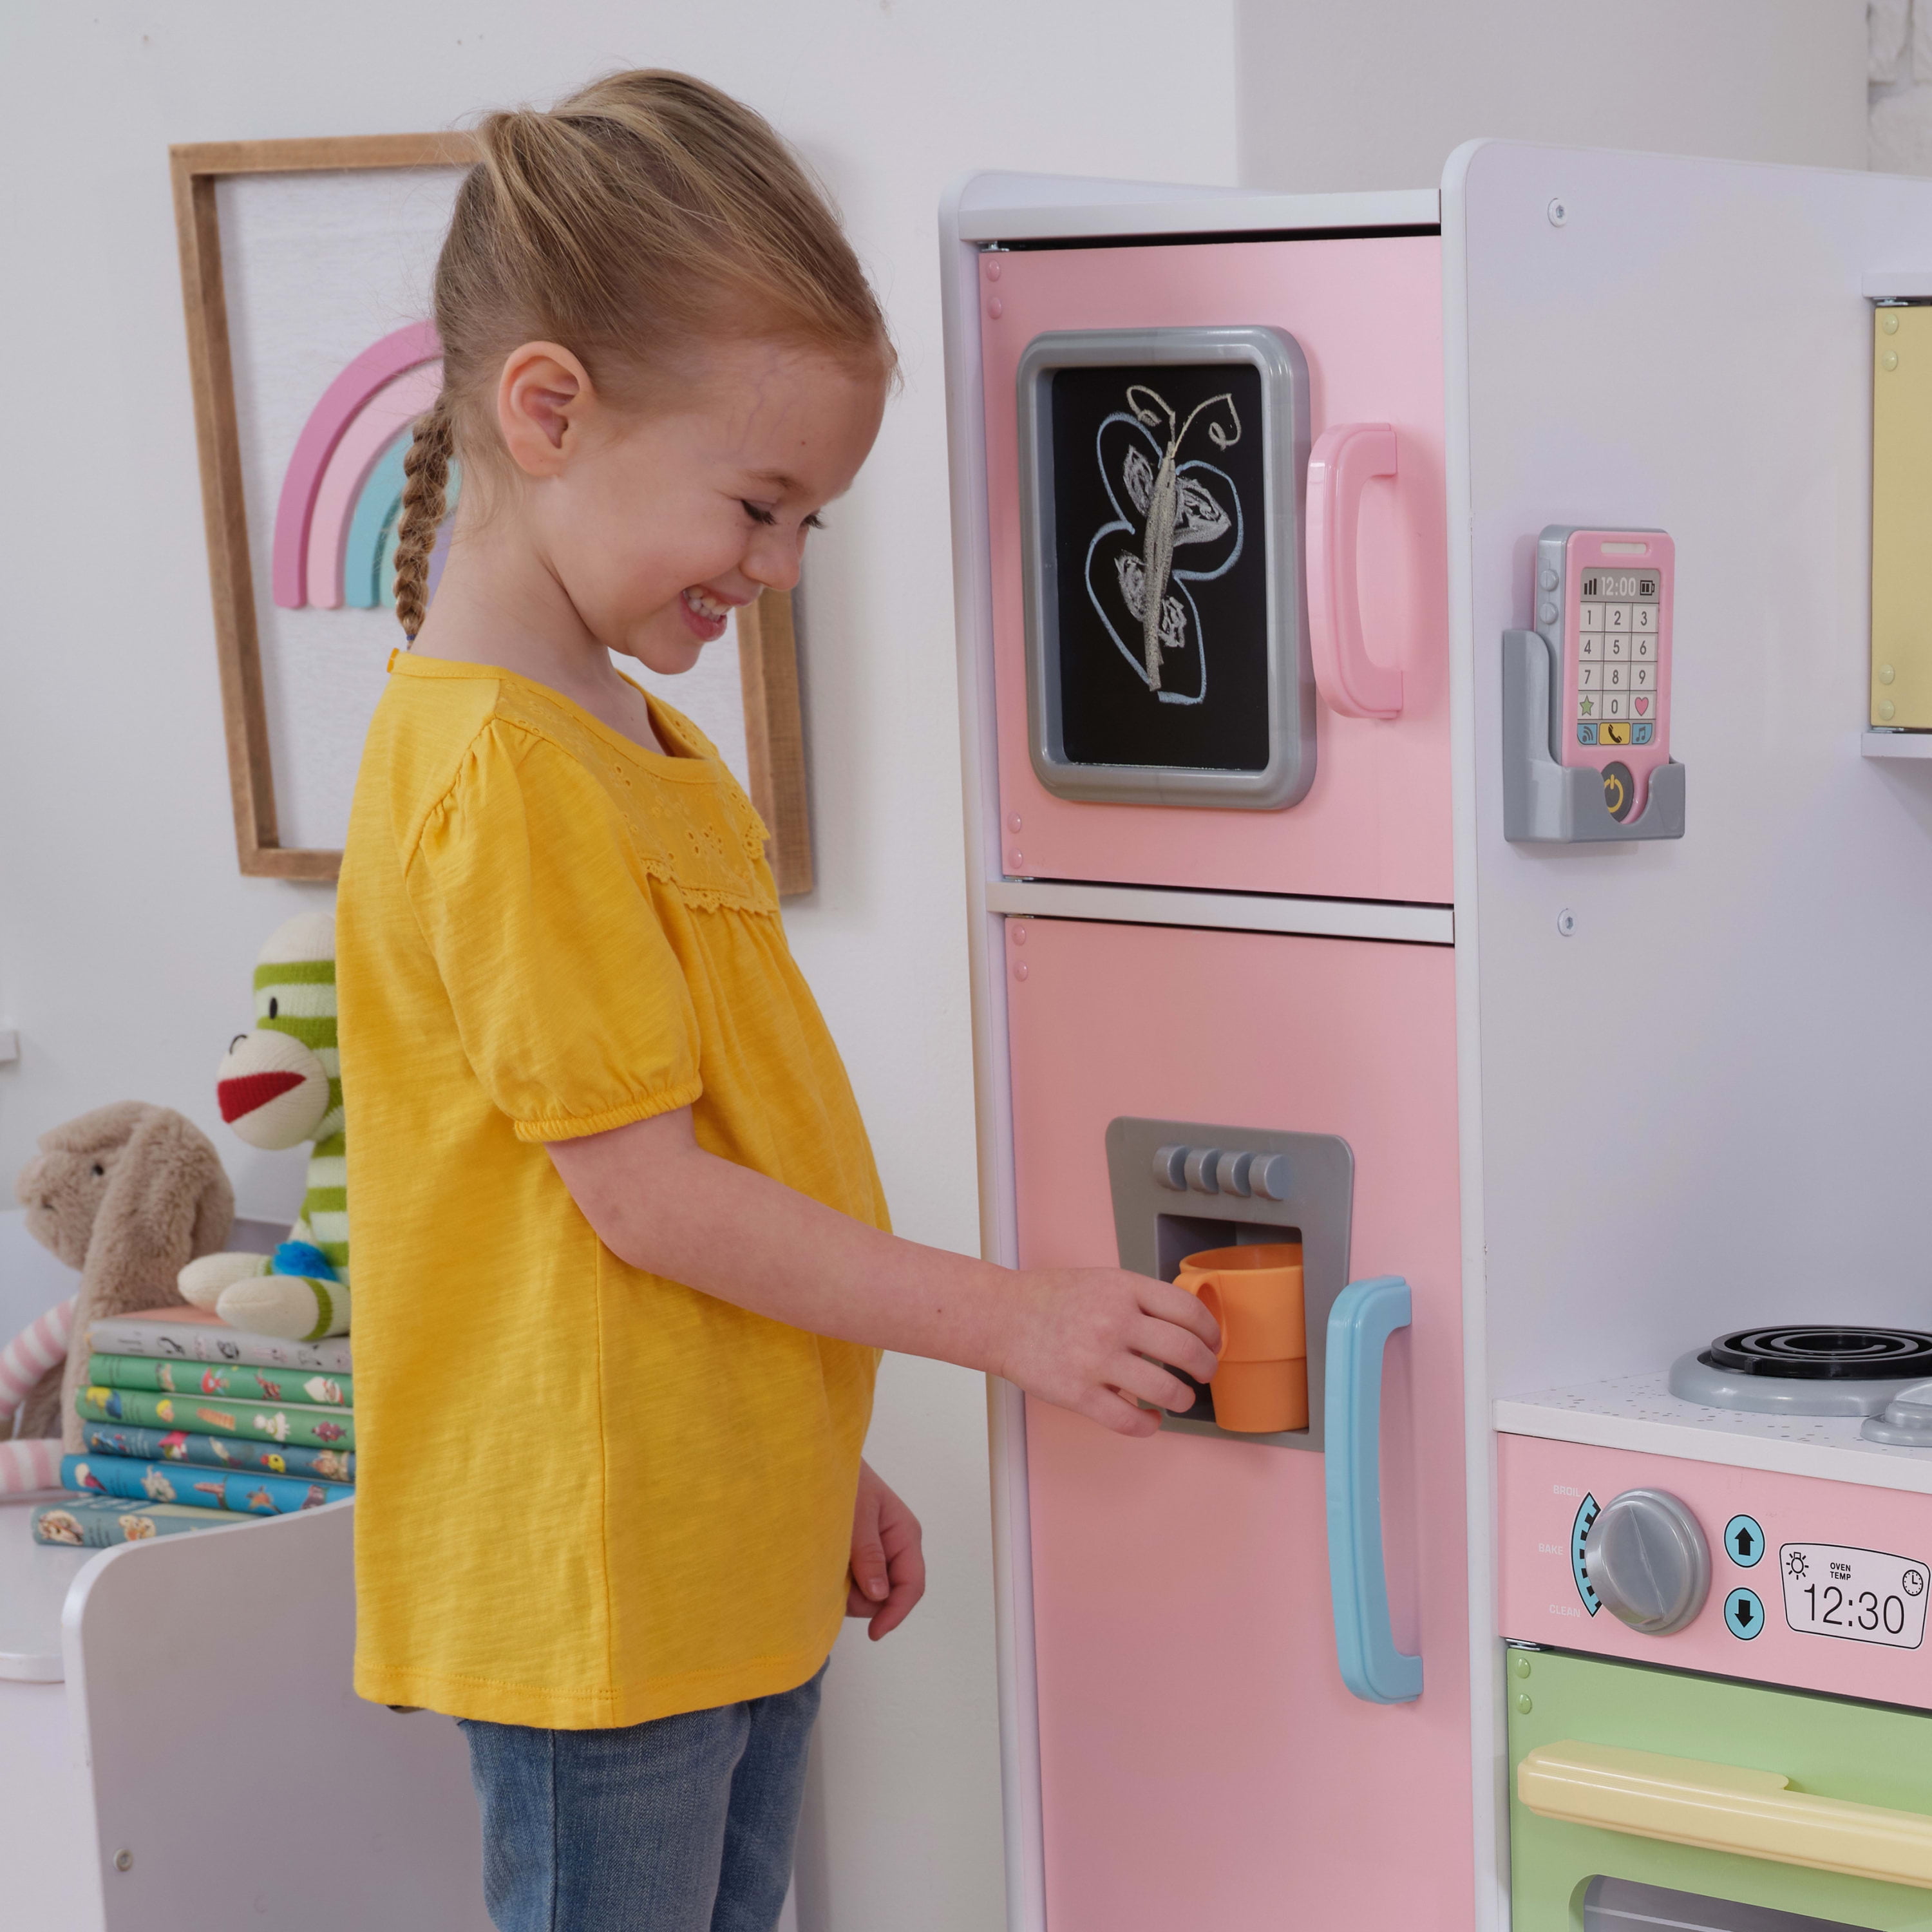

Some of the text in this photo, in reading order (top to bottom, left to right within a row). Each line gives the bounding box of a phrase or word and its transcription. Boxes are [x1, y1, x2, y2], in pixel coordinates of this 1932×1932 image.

[1602, 578, 1636, 596] 12:00
[1587, 611, 1647, 626] 1 2 3
[1584, 639, 1647, 655] 4 5 6
[1584, 670, 1645, 685] 7 8 9
[1611, 699, 1618, 714] 0
[1553, 1485, 1580, 1497] BROIL
[1539, 1543, 1564, 1555] BAKE
[1830, 1562, 1851, 1571] OVEN
[1830, 1571, 1851, 1580] TEMP
[1549, 1604, 1581, 1618] CLEAN
[1804, 1584, 1905, 1634] 12:30
